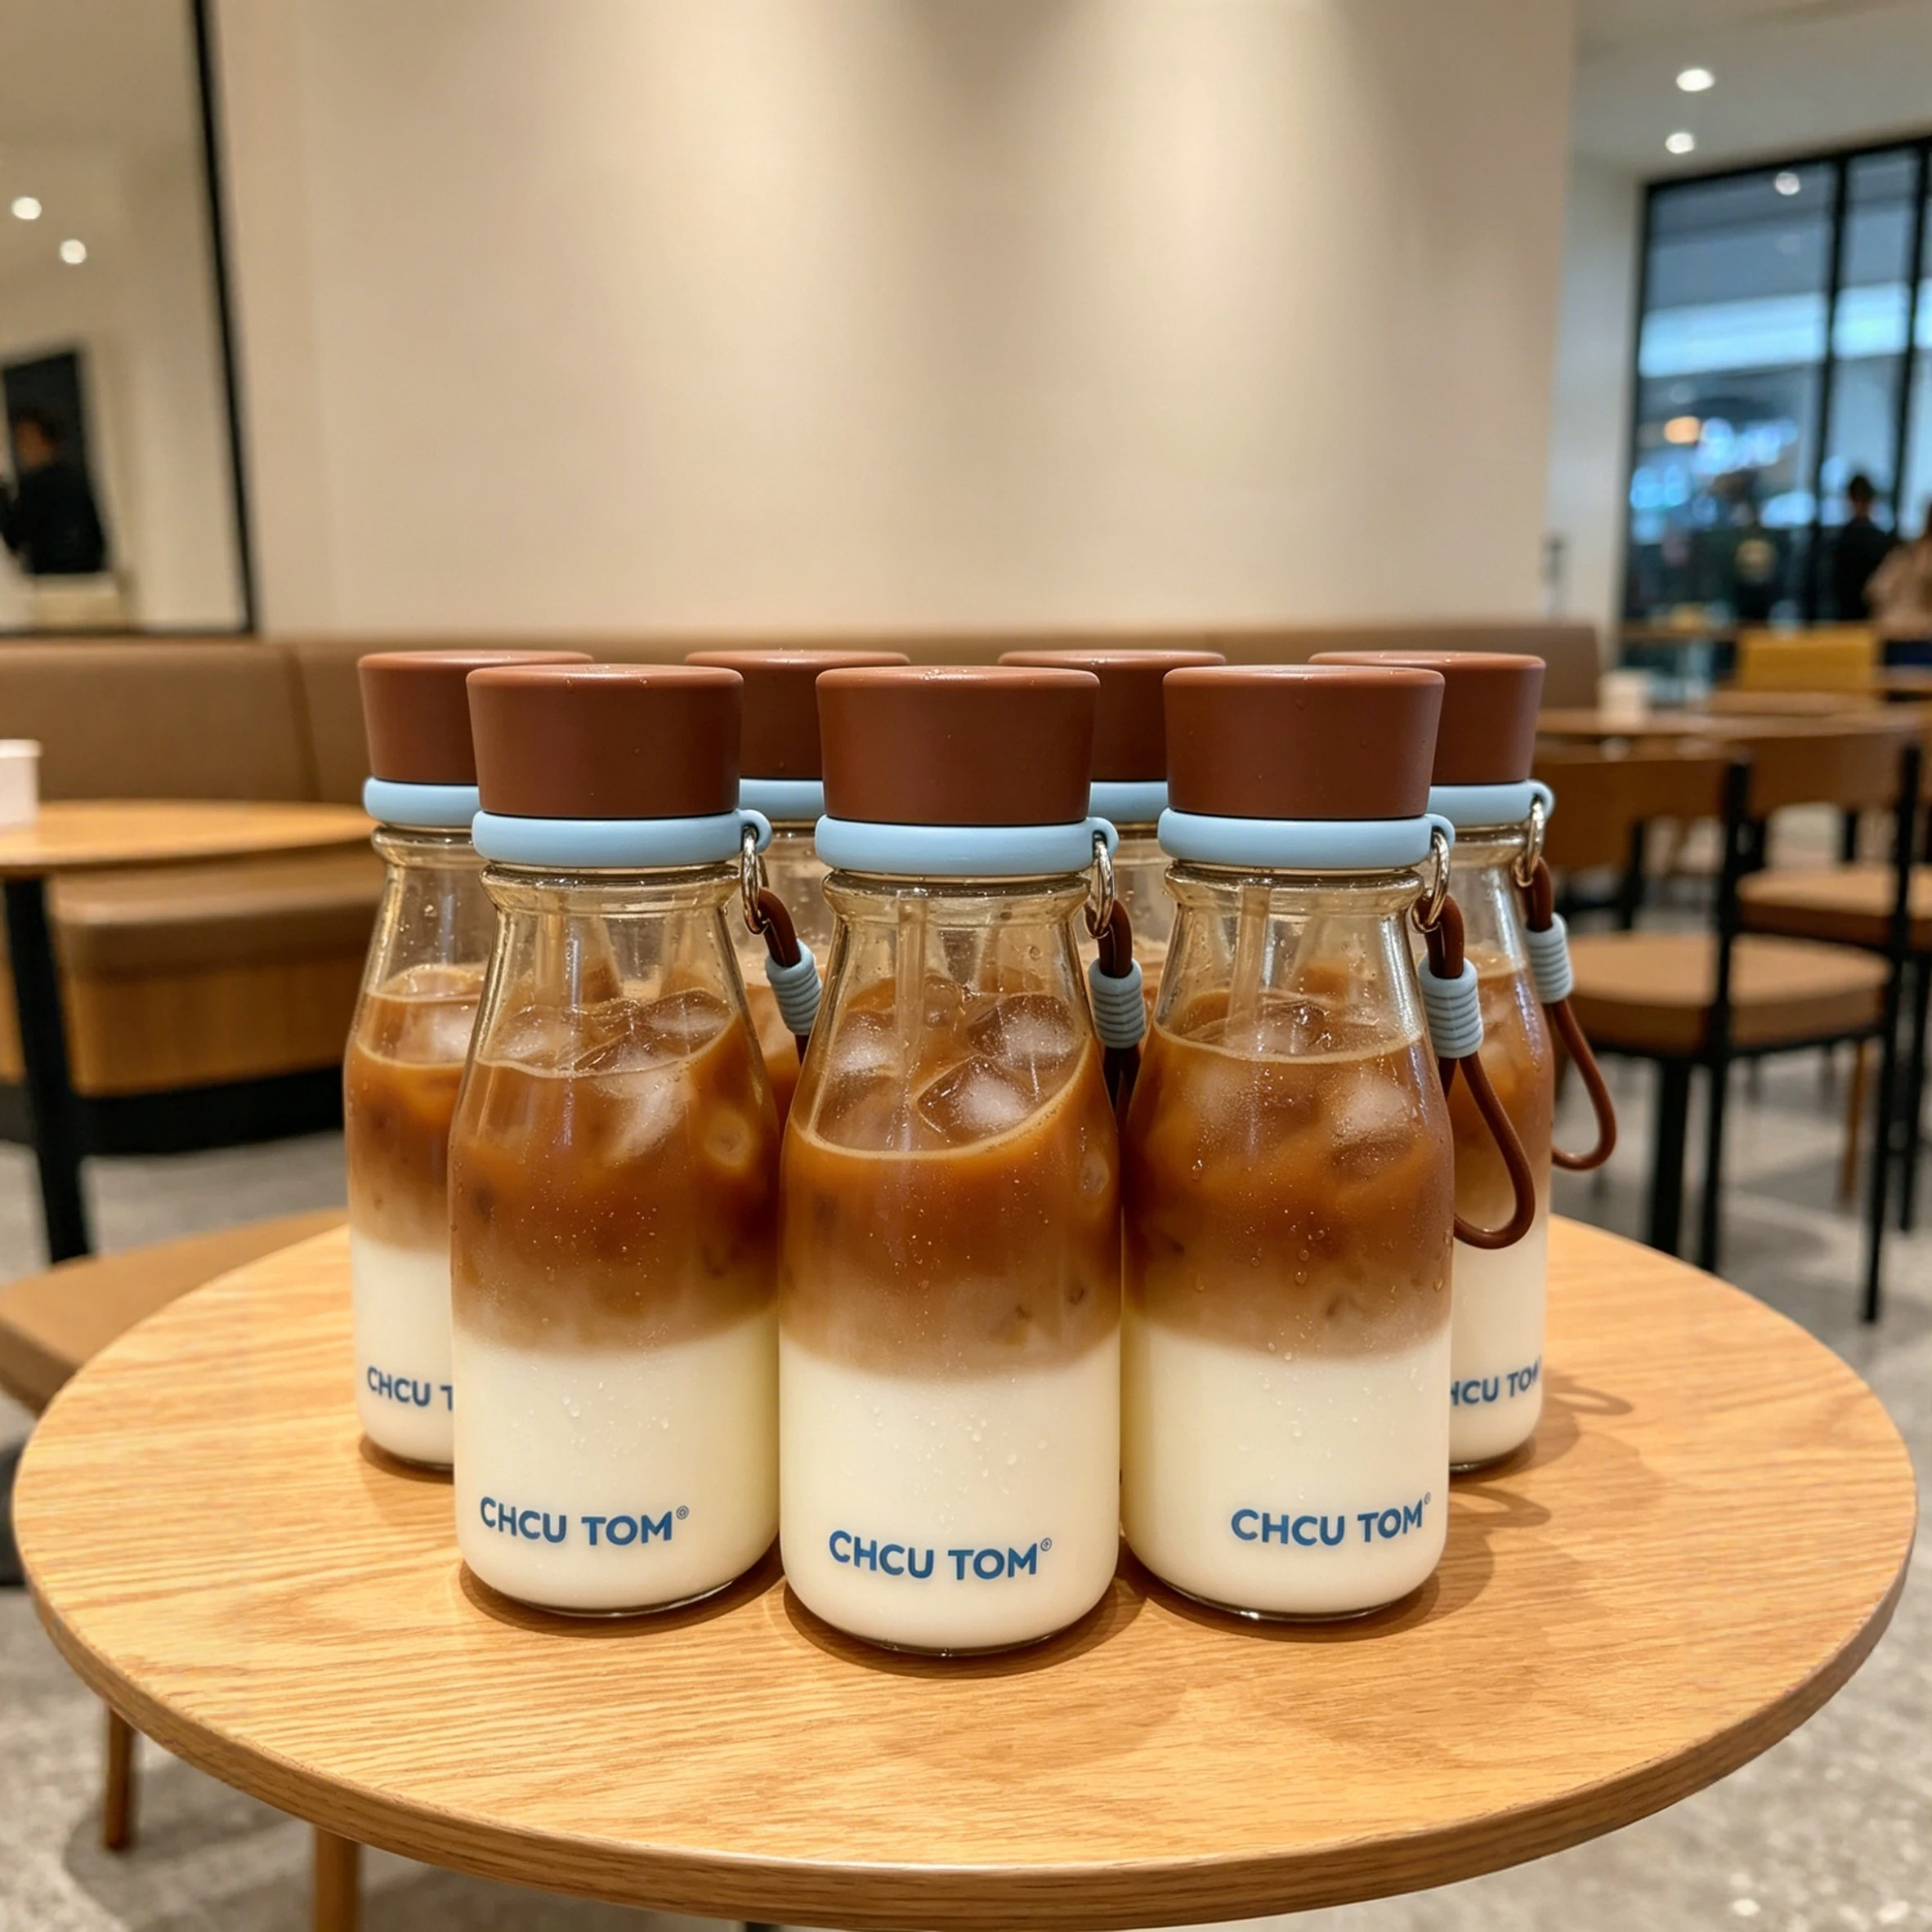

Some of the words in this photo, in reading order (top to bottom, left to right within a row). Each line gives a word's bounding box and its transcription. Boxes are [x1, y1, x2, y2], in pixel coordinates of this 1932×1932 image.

[367, 1365, 431, 1407] CHCU
[1451, 1376, 1500, 1406] HCU
[480, 1496, 566, 1543] CHCU
[1231, 1509, 1345, 1546] CHCU
[829, 1530, 935, 1579] CHCU
